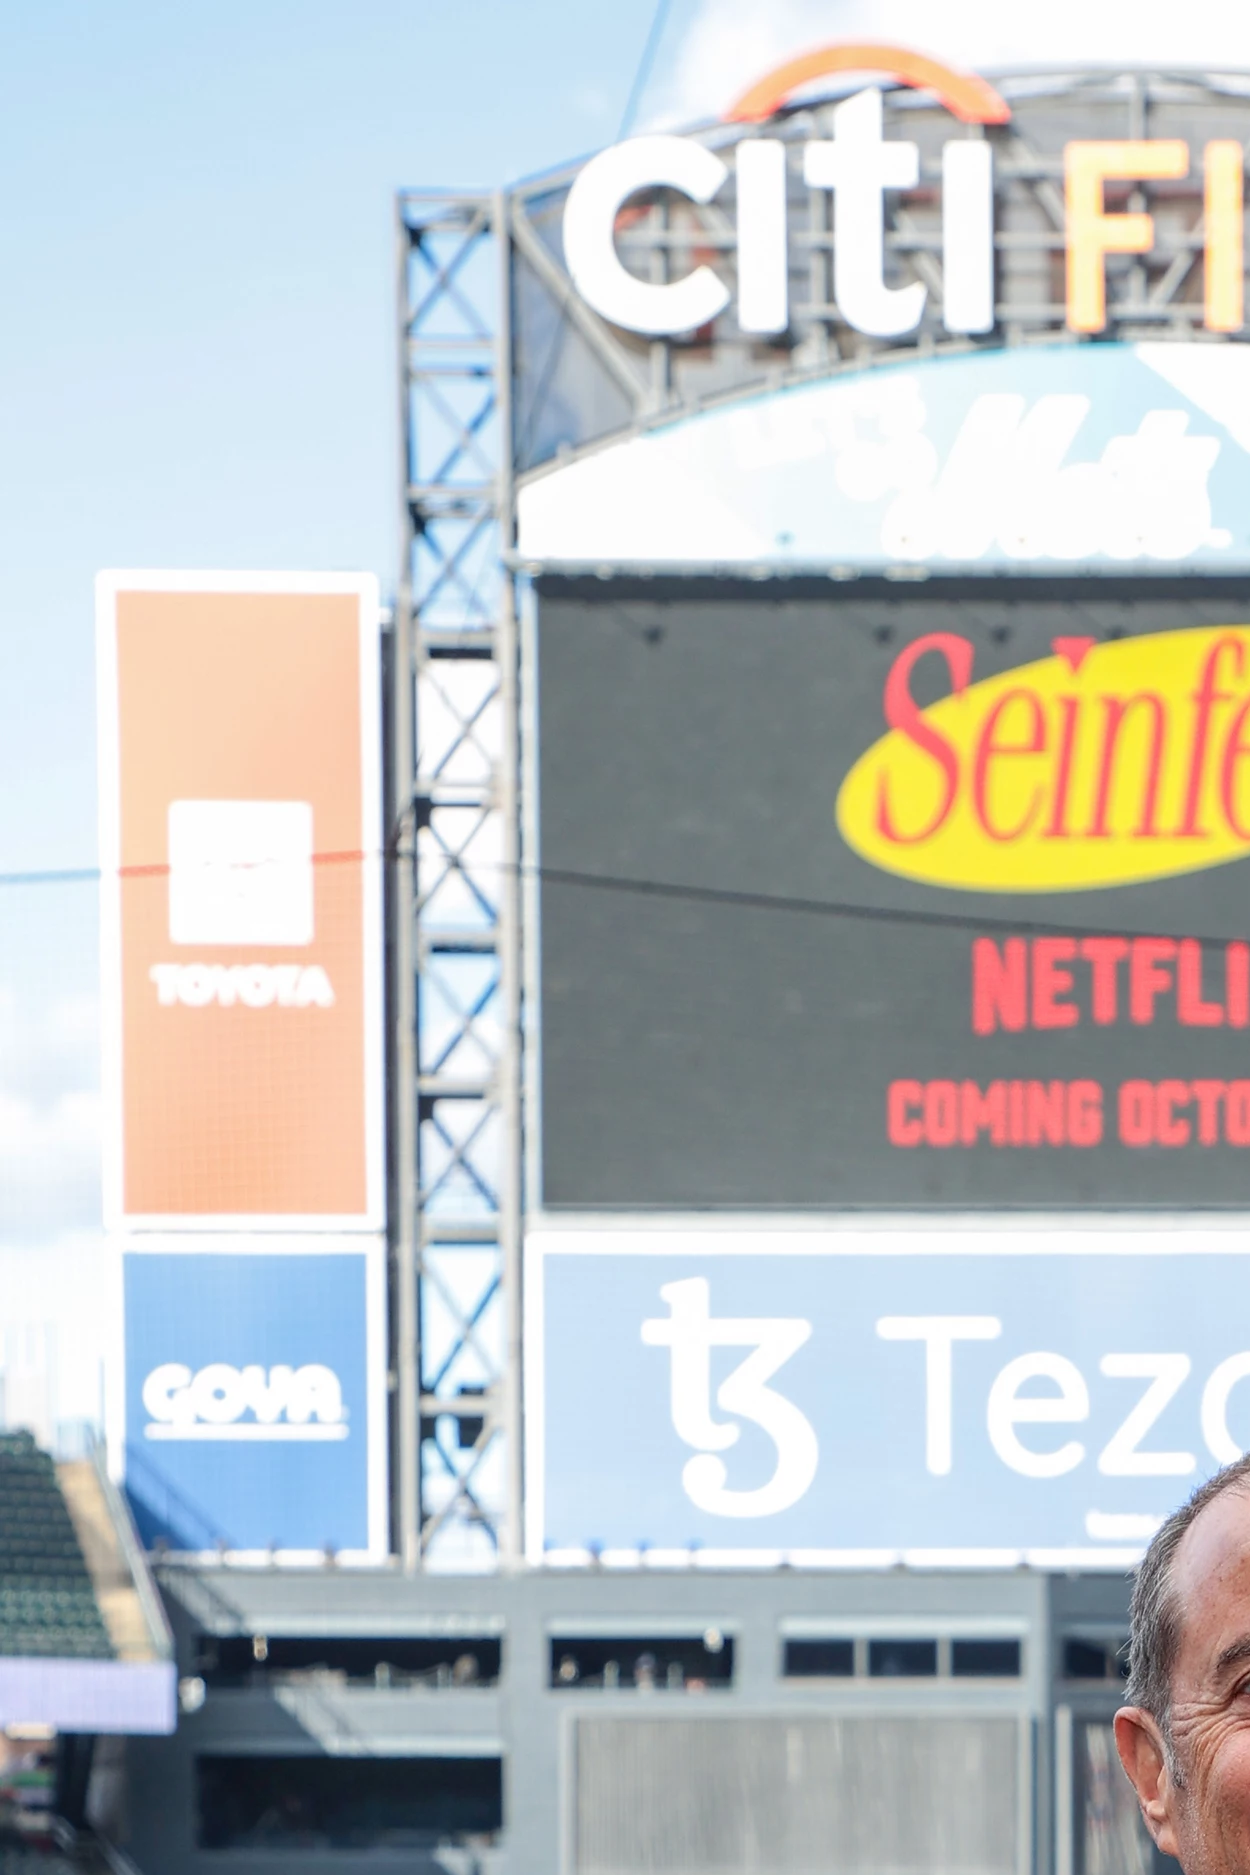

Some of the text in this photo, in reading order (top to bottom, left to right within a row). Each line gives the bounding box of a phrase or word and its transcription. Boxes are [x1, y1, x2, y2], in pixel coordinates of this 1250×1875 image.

[562, 85, 995, 336] citi
[149, 963, 335, 1007] TOYOTA
[887, 1079, 1103, 1148] COMING
[142, 1362, 345, 1424] GOYA
